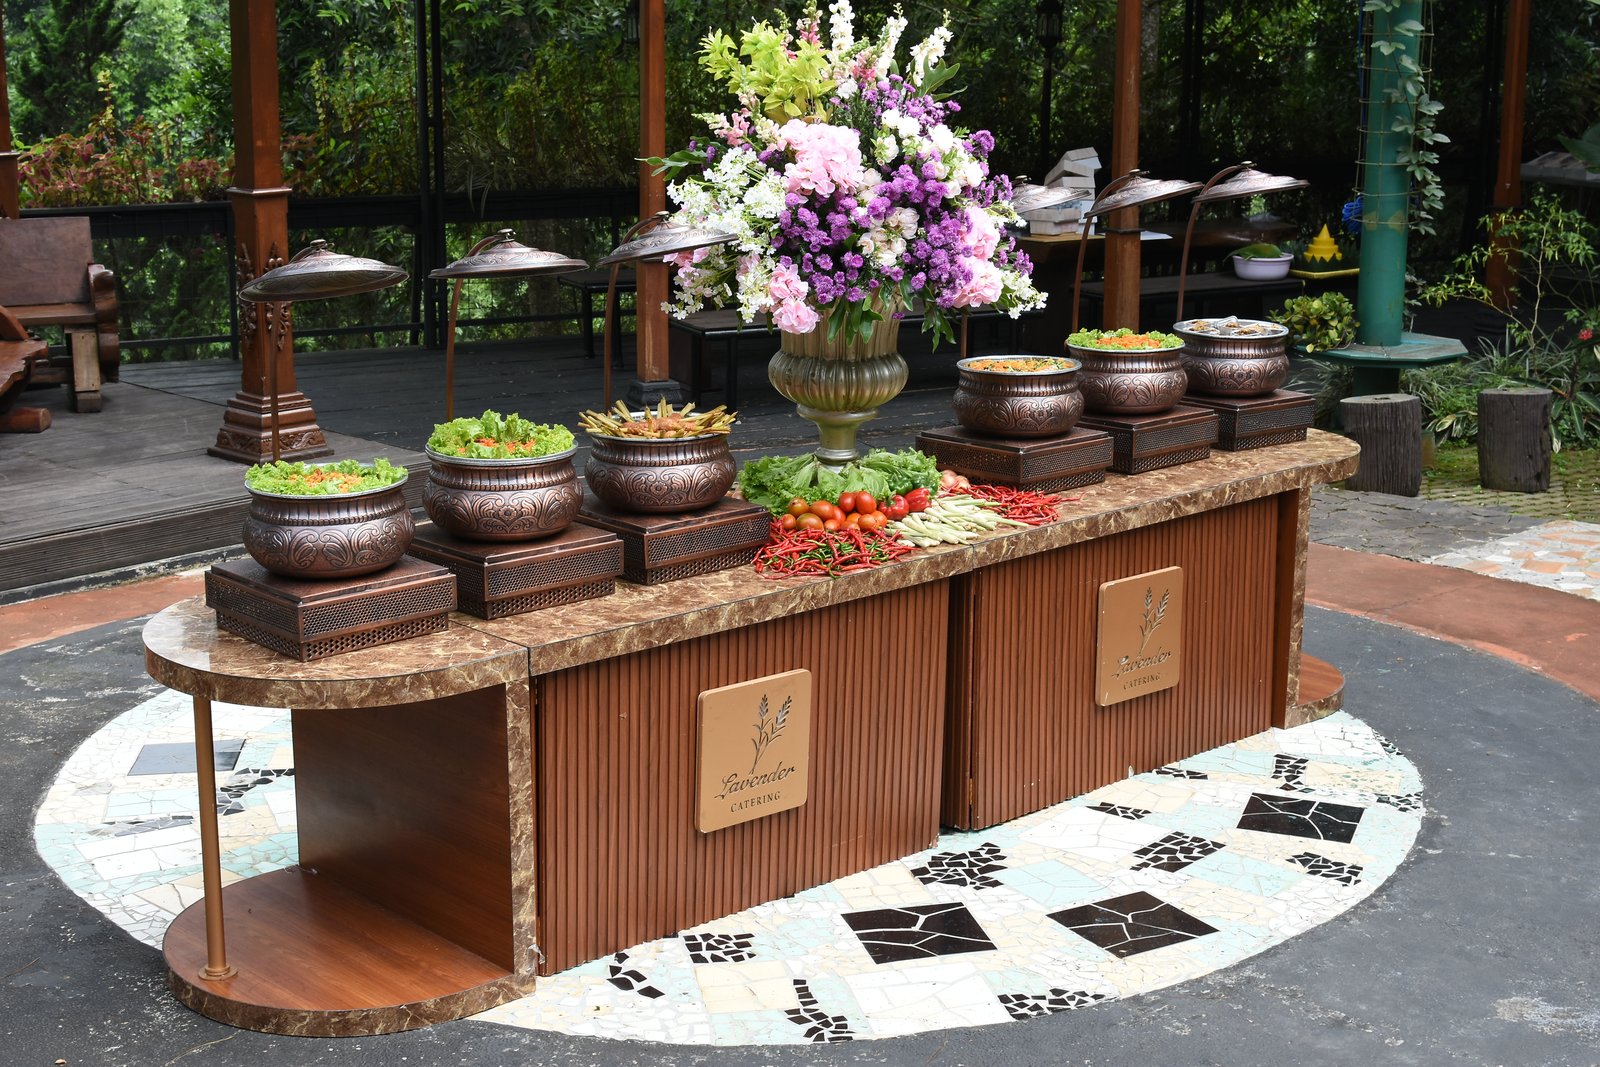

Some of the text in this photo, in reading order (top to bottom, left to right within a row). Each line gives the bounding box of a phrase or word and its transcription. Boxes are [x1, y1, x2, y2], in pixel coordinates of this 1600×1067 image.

[1112, 647, 1172, 678] Lavender
[1123, 672, 1161, 690] CATERING
[714, 761, 796, 800] Lavender
[730, 791, 781, 813] CATERING
